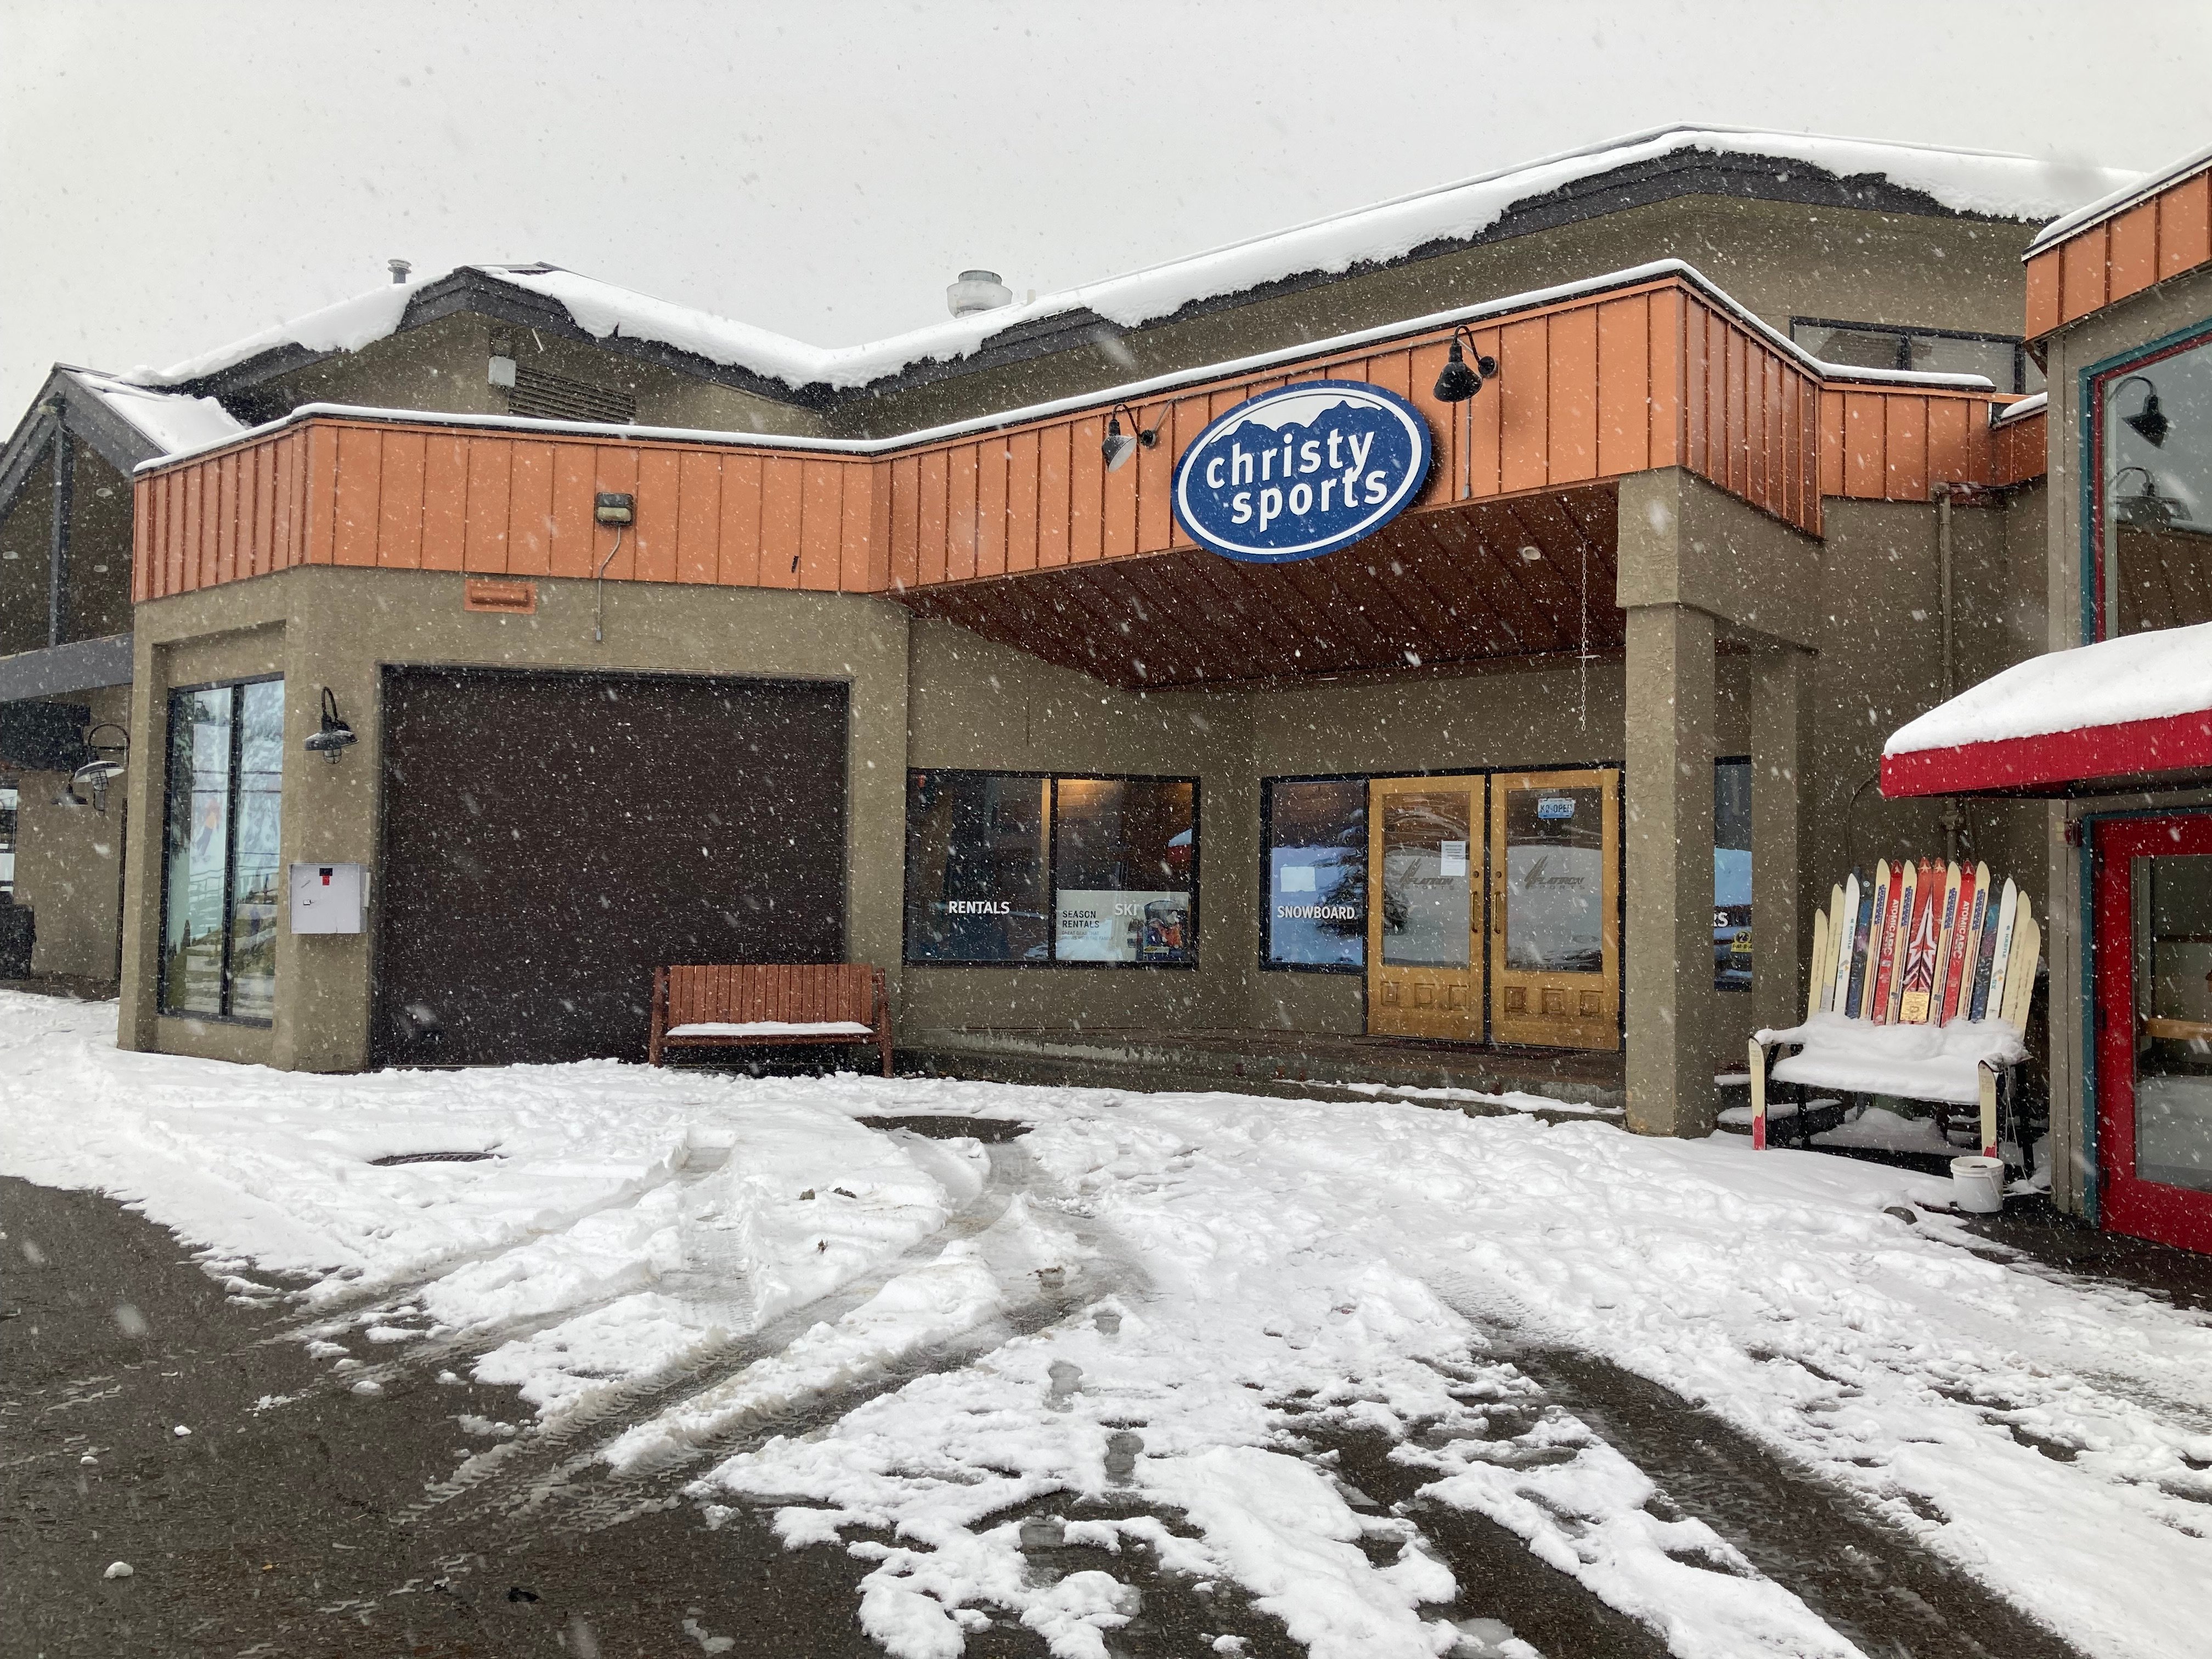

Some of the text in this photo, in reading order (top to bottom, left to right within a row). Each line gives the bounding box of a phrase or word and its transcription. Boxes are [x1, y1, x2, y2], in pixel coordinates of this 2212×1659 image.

[1207, 428, 1374, 489] christy
[1232, 466, 1387, 533] sports
[949, 901, 1011, 914] RENTALS
[1062, 910, 1096, 918] SEASON
[1114, 903, 1137, 916] SKI
[1277, 905, 1355, 919] SNOWBOARD
[1883, 899, 1899, 957] ATOMIC ARC
[1953, 900, 1970, 960] ATOMIC ARC
